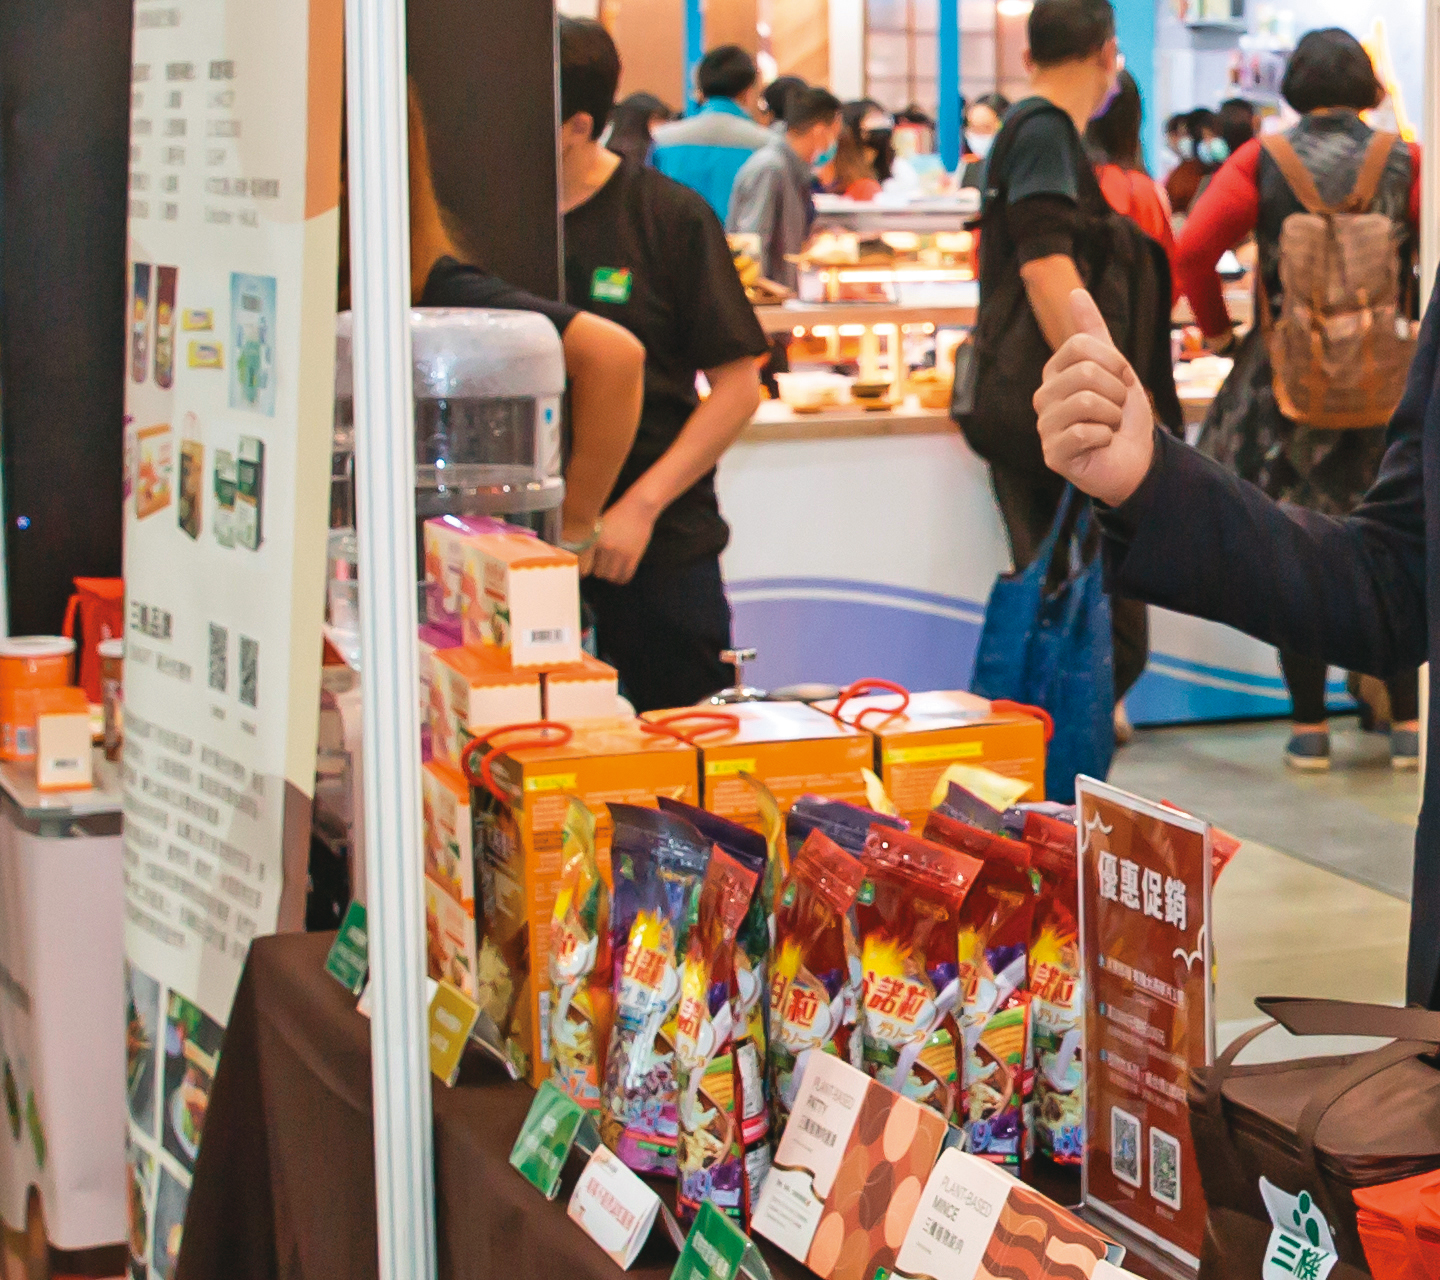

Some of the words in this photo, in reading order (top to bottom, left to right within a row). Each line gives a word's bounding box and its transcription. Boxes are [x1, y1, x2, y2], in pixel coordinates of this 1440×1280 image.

[1097, 849, 1188, 932] 優惠促銷
[932, 1194, 960, 1223] MINCE
[942, 1175, 992, 1219] PLANT-BASED
